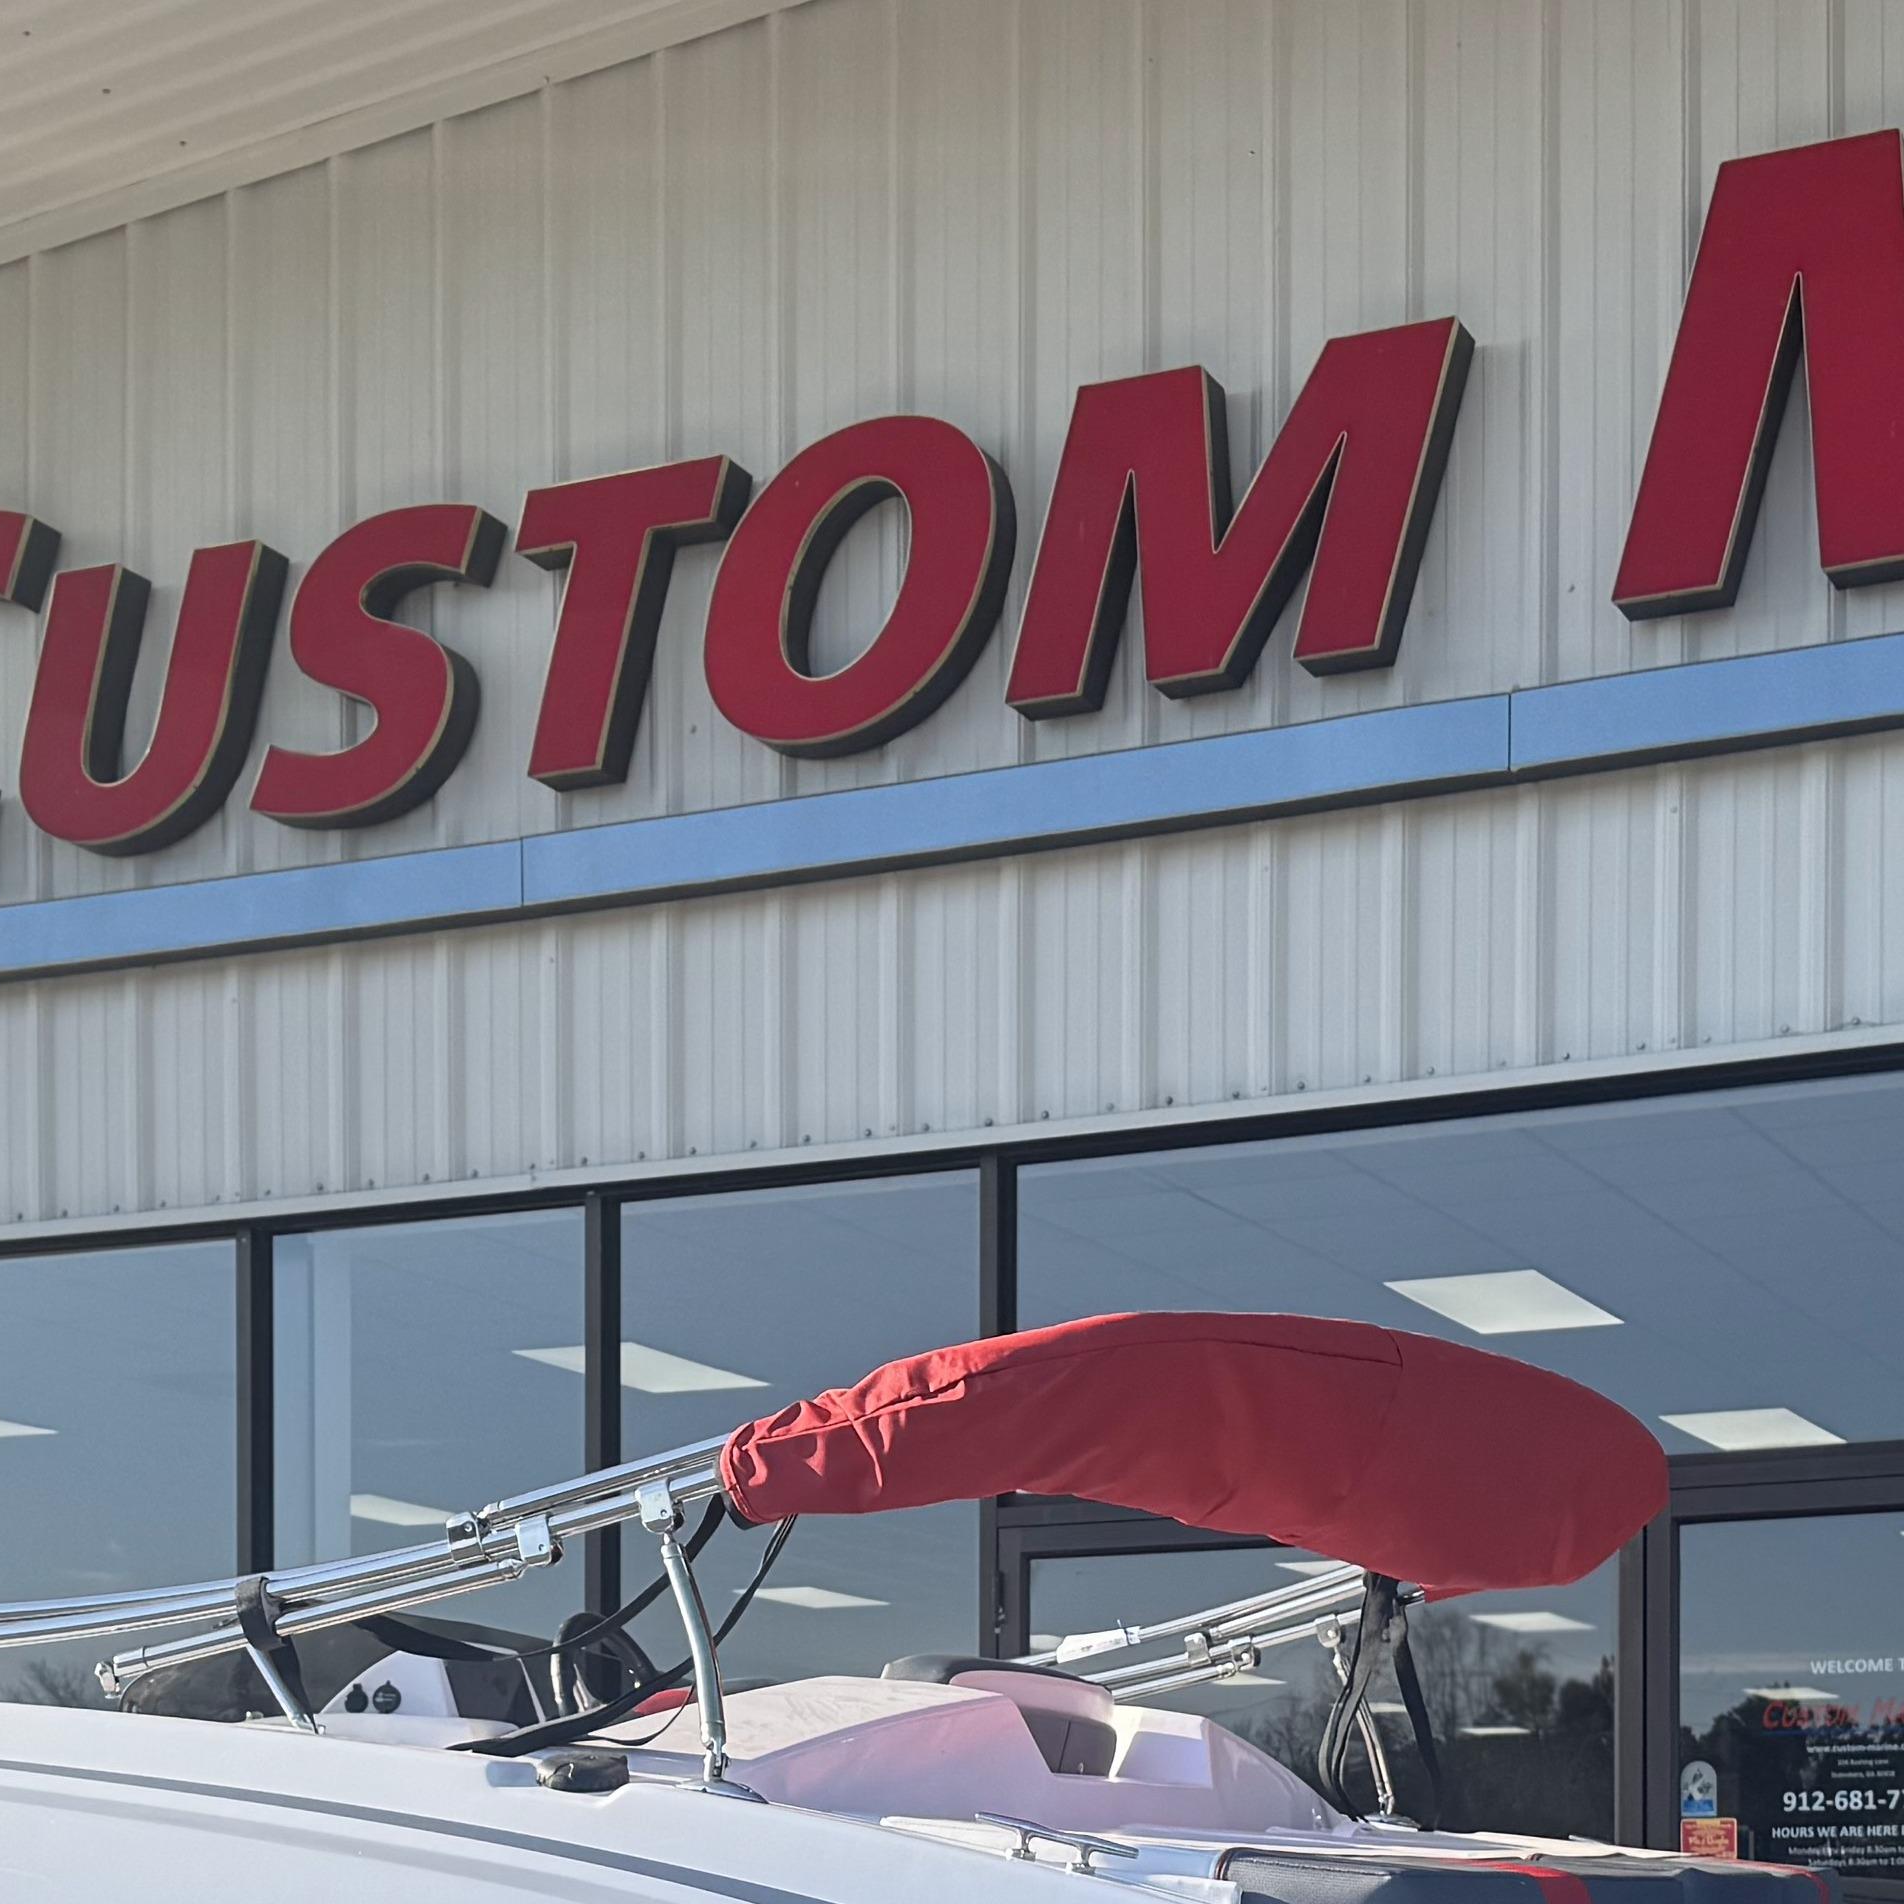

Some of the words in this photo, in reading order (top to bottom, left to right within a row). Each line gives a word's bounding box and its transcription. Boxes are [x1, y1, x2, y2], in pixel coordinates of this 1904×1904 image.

[1810, 1658, 1894, 1675] WELCOME
[1771, 1827, 1815, 1839] HOURS
[1817, 1826, 1838, 1838] WE
[1839, 1825, 1864, 1837] ARE
[1866, 1825, 1897, 1837] HERE
